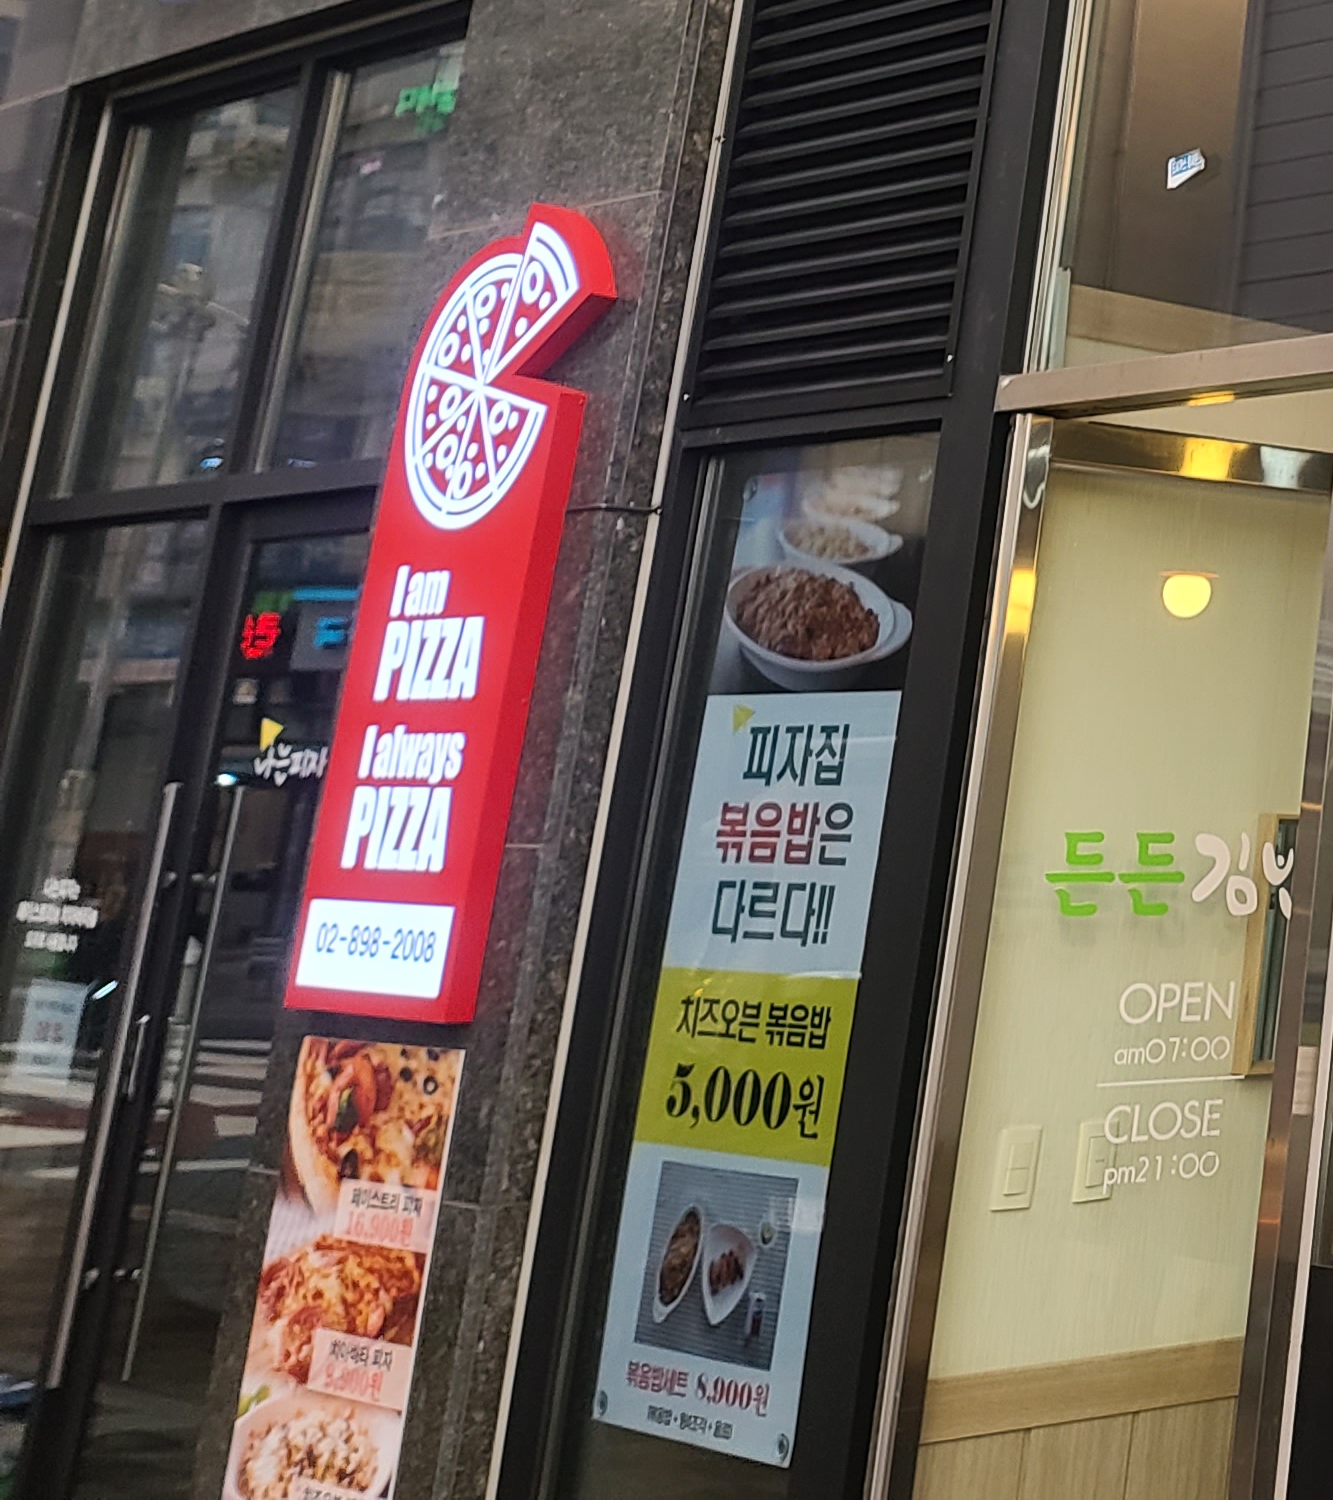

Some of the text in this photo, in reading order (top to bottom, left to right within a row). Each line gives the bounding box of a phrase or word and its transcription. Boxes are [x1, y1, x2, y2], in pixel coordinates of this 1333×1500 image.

[389, 563, 451, 618] I am
[372, 615, 485, 702] PIZZA
[357, 724, 466, 785] I always
[742, 723, 851, 787] 피자집
[340, 784, 453, 874] PIZZA
[715, 801, 855, 867] 볶음밥은
[315, 921, 437, 964] 02-898-2008
[711, 879, 836, 948] 다르다!!
[675, 995, 833, 1050] 치즈오븐 볶음밥
[1118, 980, 1236, 1025] OPEN
[665, 1061, 825, 1140] 5,000원
[1103, 1098, 1224, 1146] CLOSE
[625, 1359, 690, 1398] 볶음밥세트
